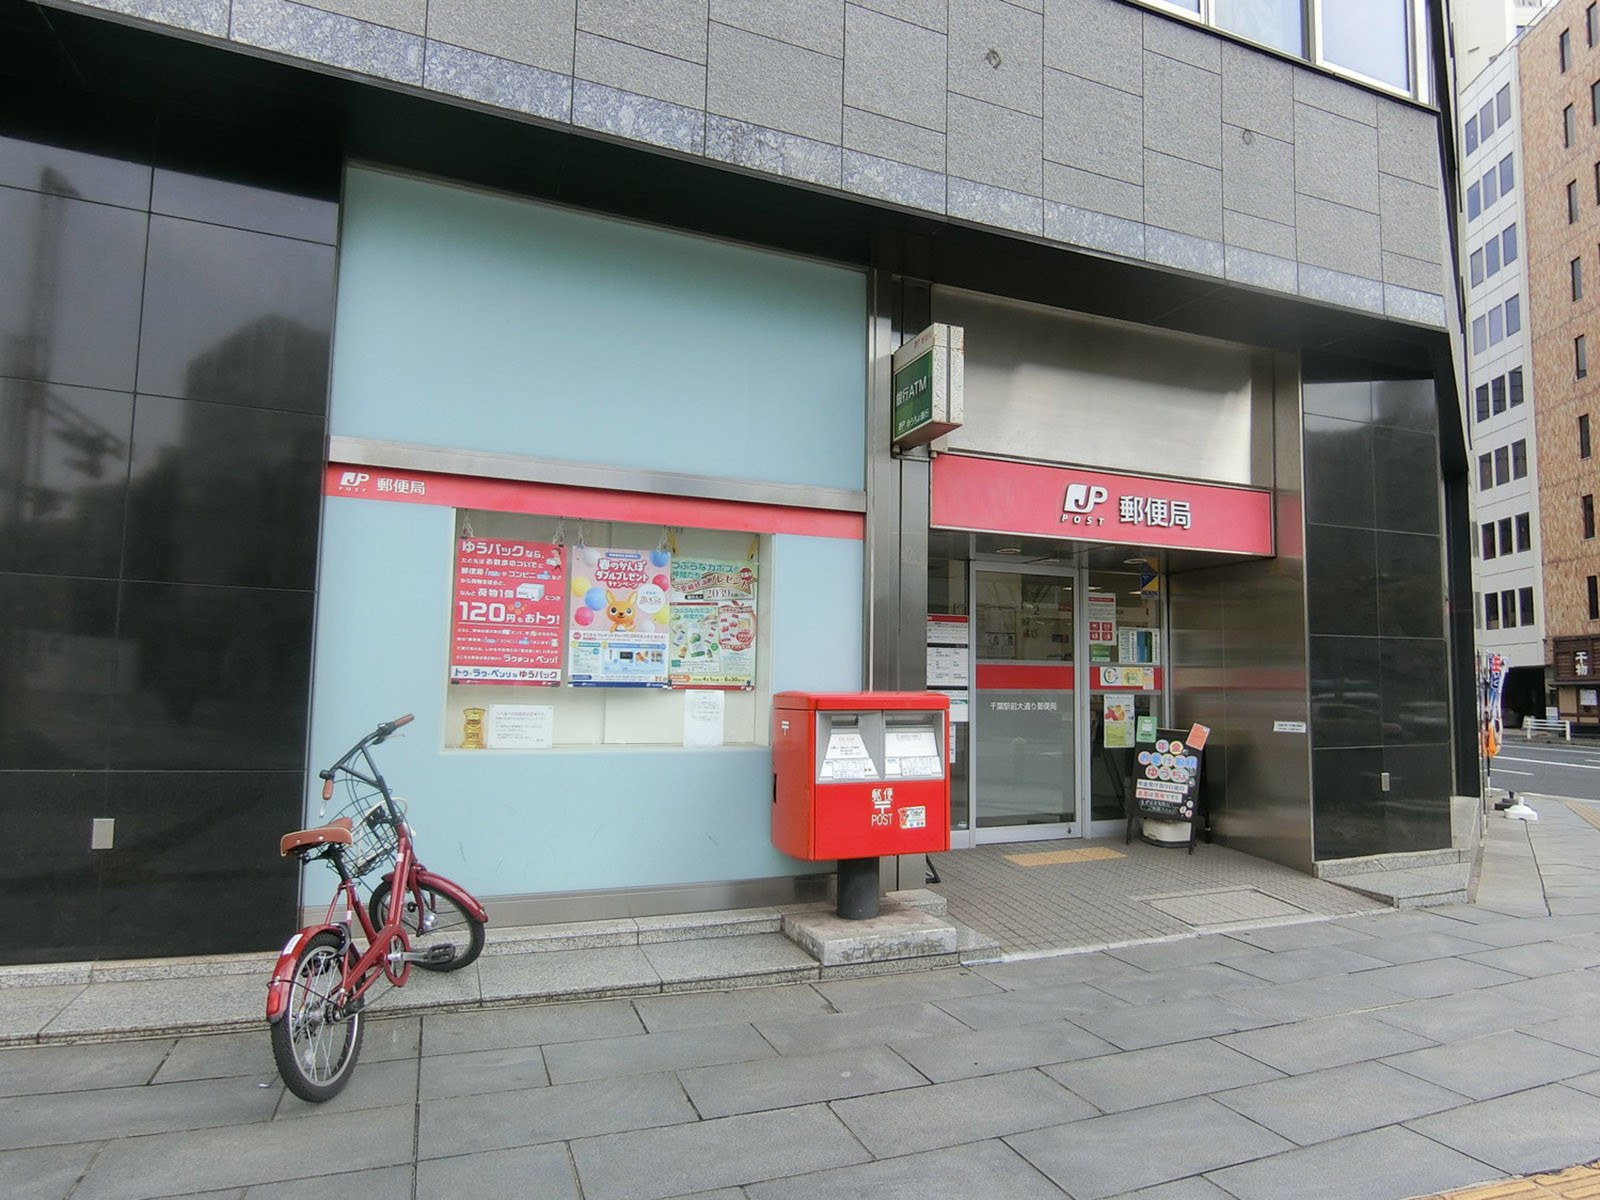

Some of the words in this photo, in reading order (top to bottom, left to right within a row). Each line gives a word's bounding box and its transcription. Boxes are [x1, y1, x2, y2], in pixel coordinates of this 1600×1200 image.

[896, 376, 927, 406] 銀行ATM
[377, 478, 425, 495] 郵便局
[1119, 495, 1191, 529] 郵便局
[1061, 513, 1105, 526] POST
[597, 571, 648, 583] ダブルプレゼント
[990, 701, 1058, 711] 千葉駅前大通り郵便局
[872, 788, 894, 802] 郵便
[871, 813, 894, 826] POST
